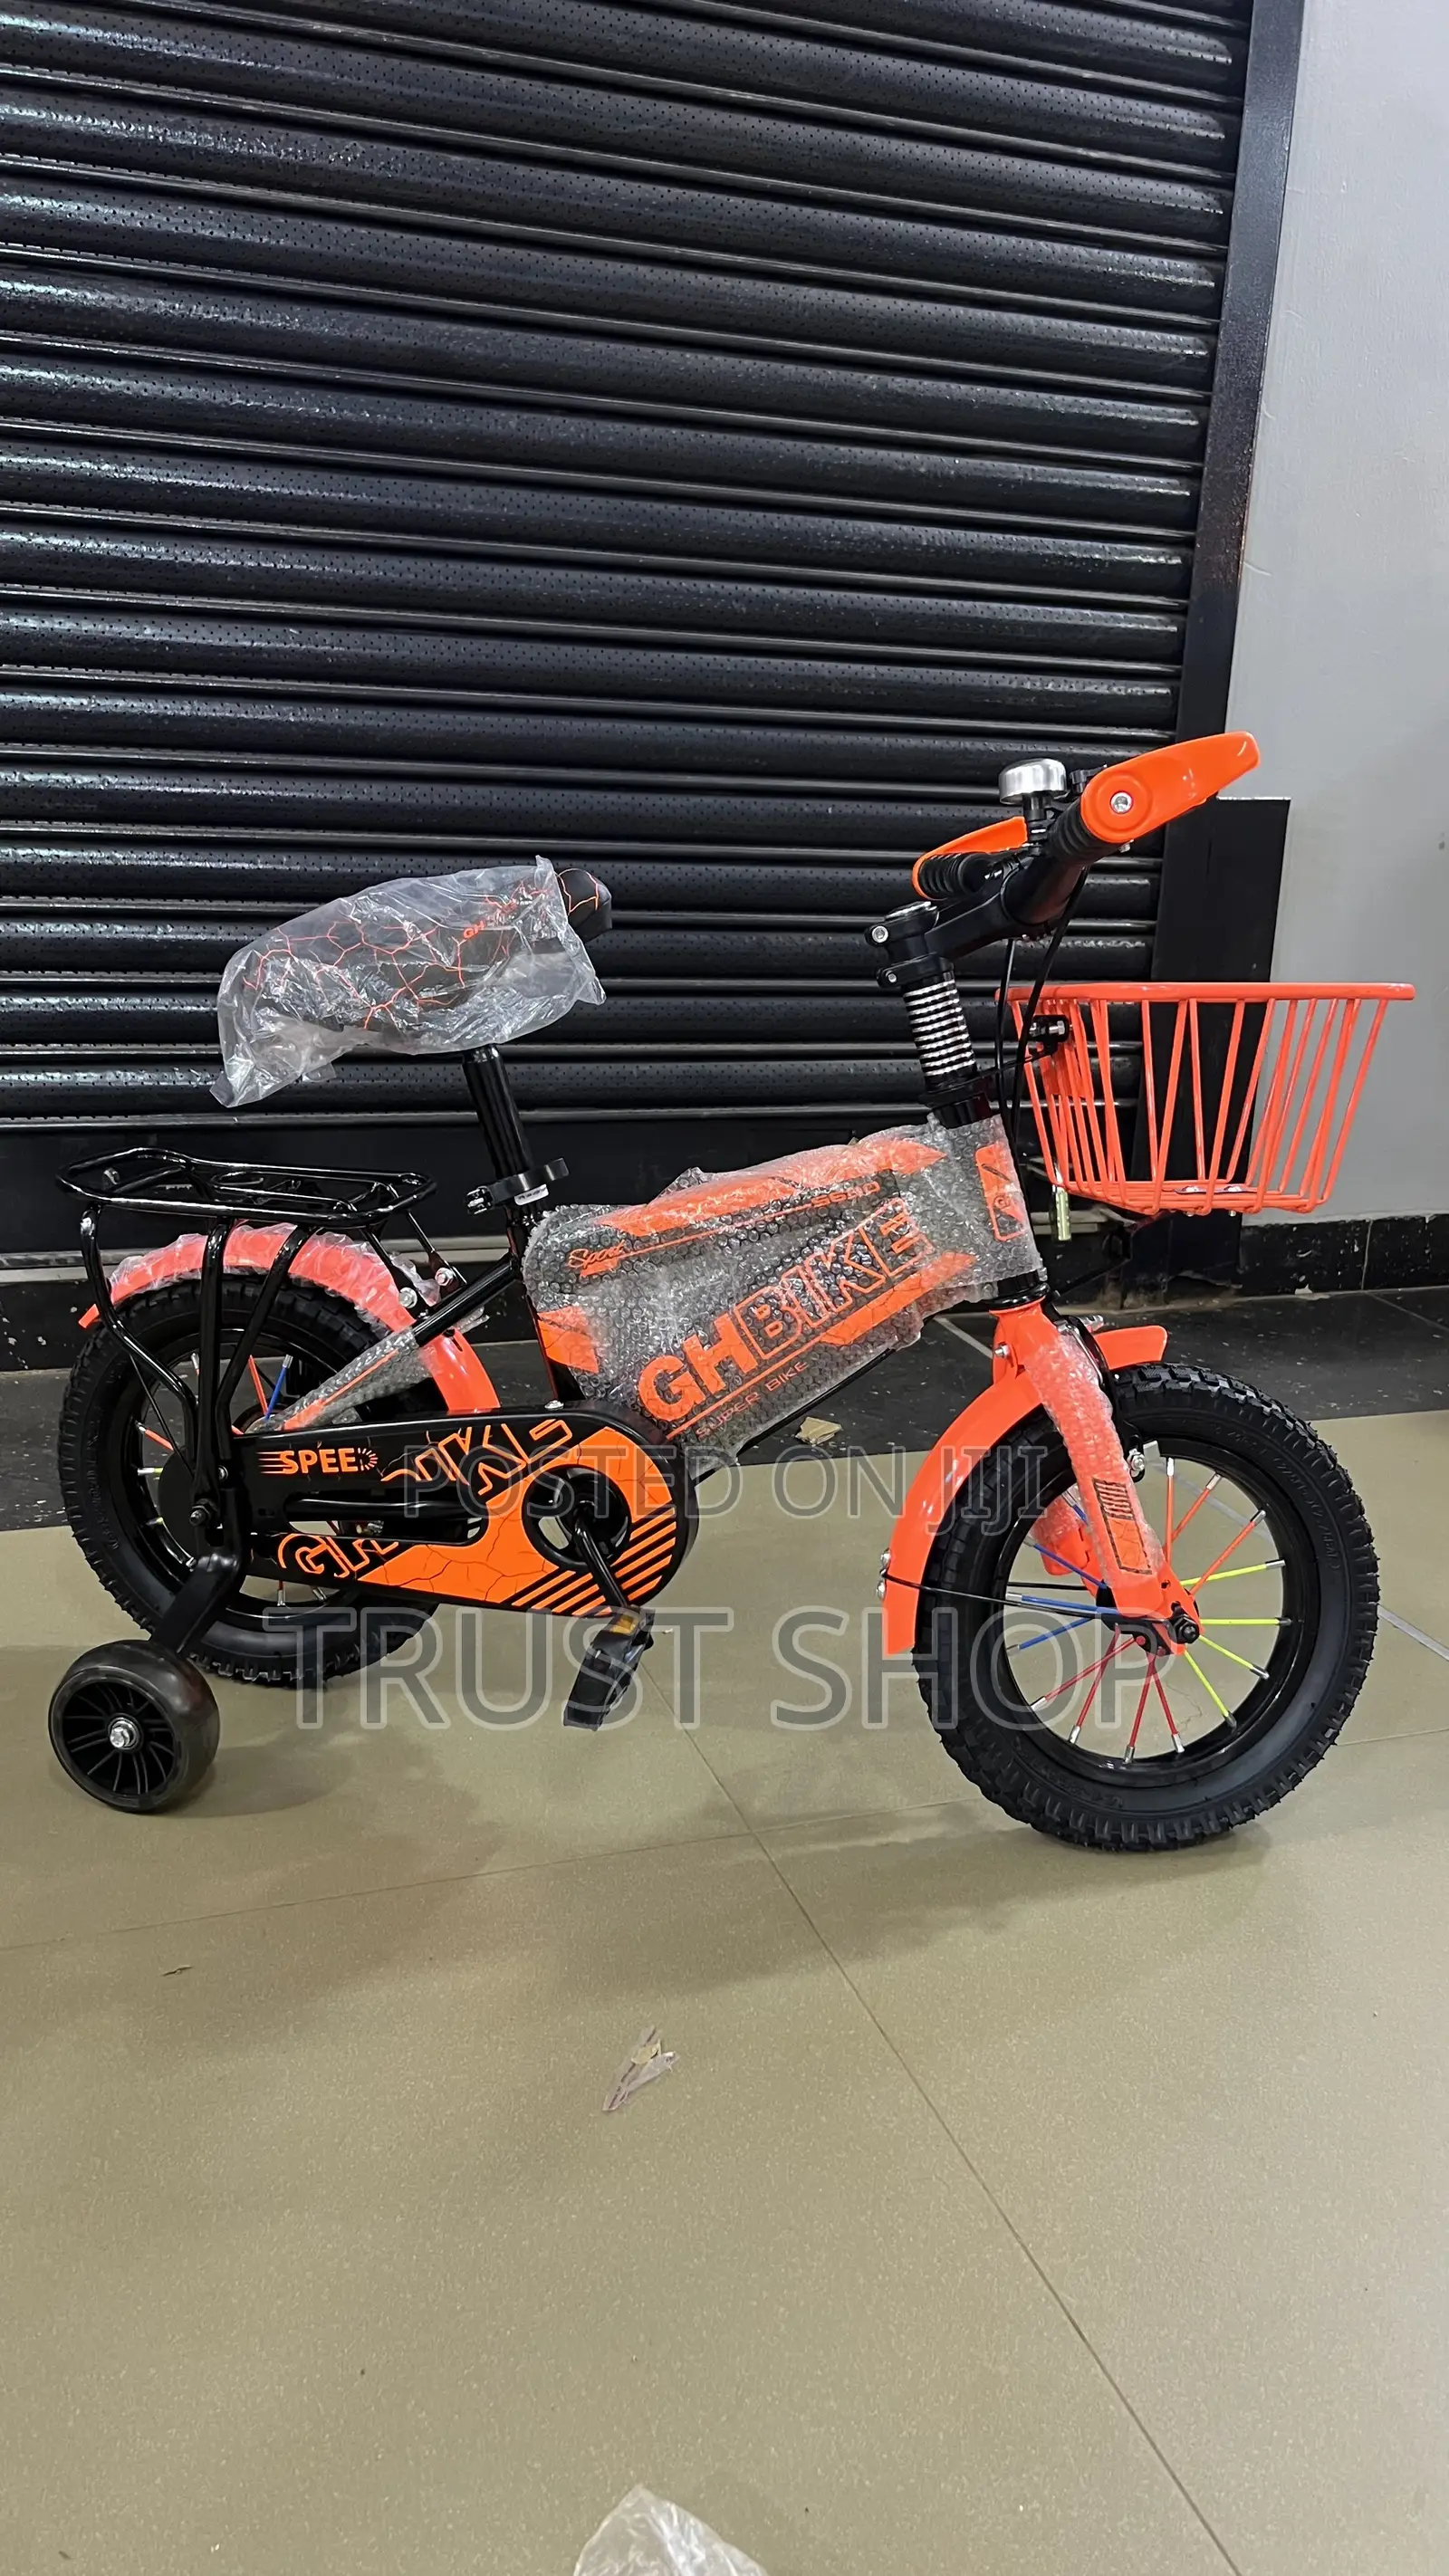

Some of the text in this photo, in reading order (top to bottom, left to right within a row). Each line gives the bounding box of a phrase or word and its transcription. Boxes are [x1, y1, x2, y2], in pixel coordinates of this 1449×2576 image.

[695, 1361, 810, 1441] SUPER BIKE
[275, 1447, 379, 1475] SPEED
